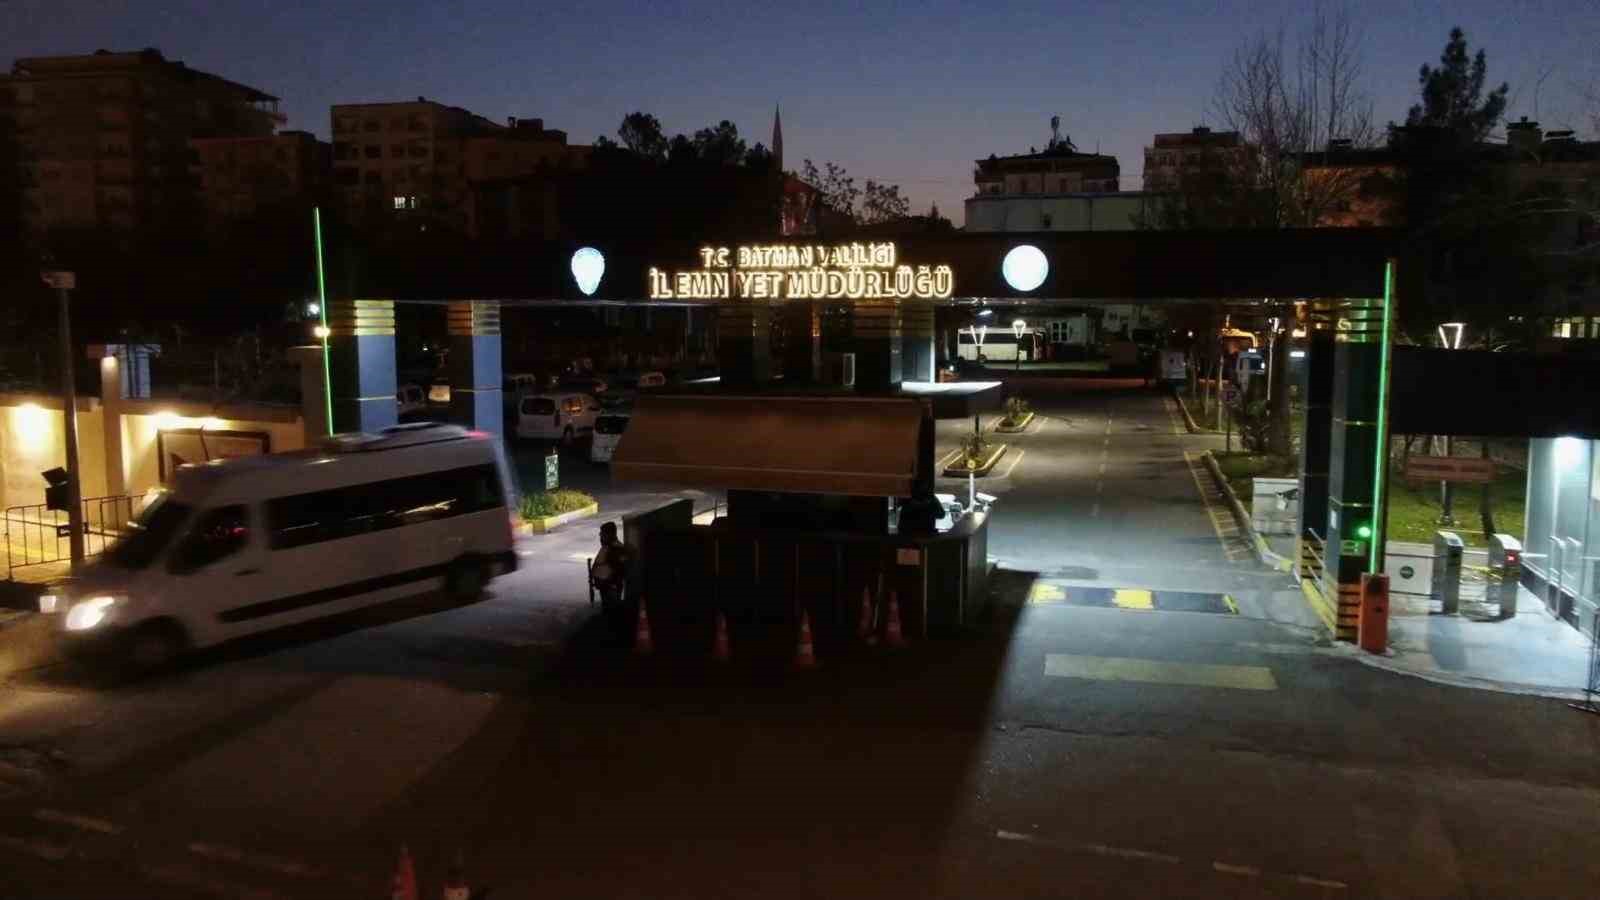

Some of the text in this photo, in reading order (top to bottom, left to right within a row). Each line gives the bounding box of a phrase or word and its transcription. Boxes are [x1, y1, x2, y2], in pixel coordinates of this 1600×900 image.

[736, 245, 814, 267] BATMAN
[816, 242, 896, 266] VALİLİĞİ
[649, 267, 673, 298] İL
[785, 265, 953, 298] MÜDÜRLÜĞÜ
